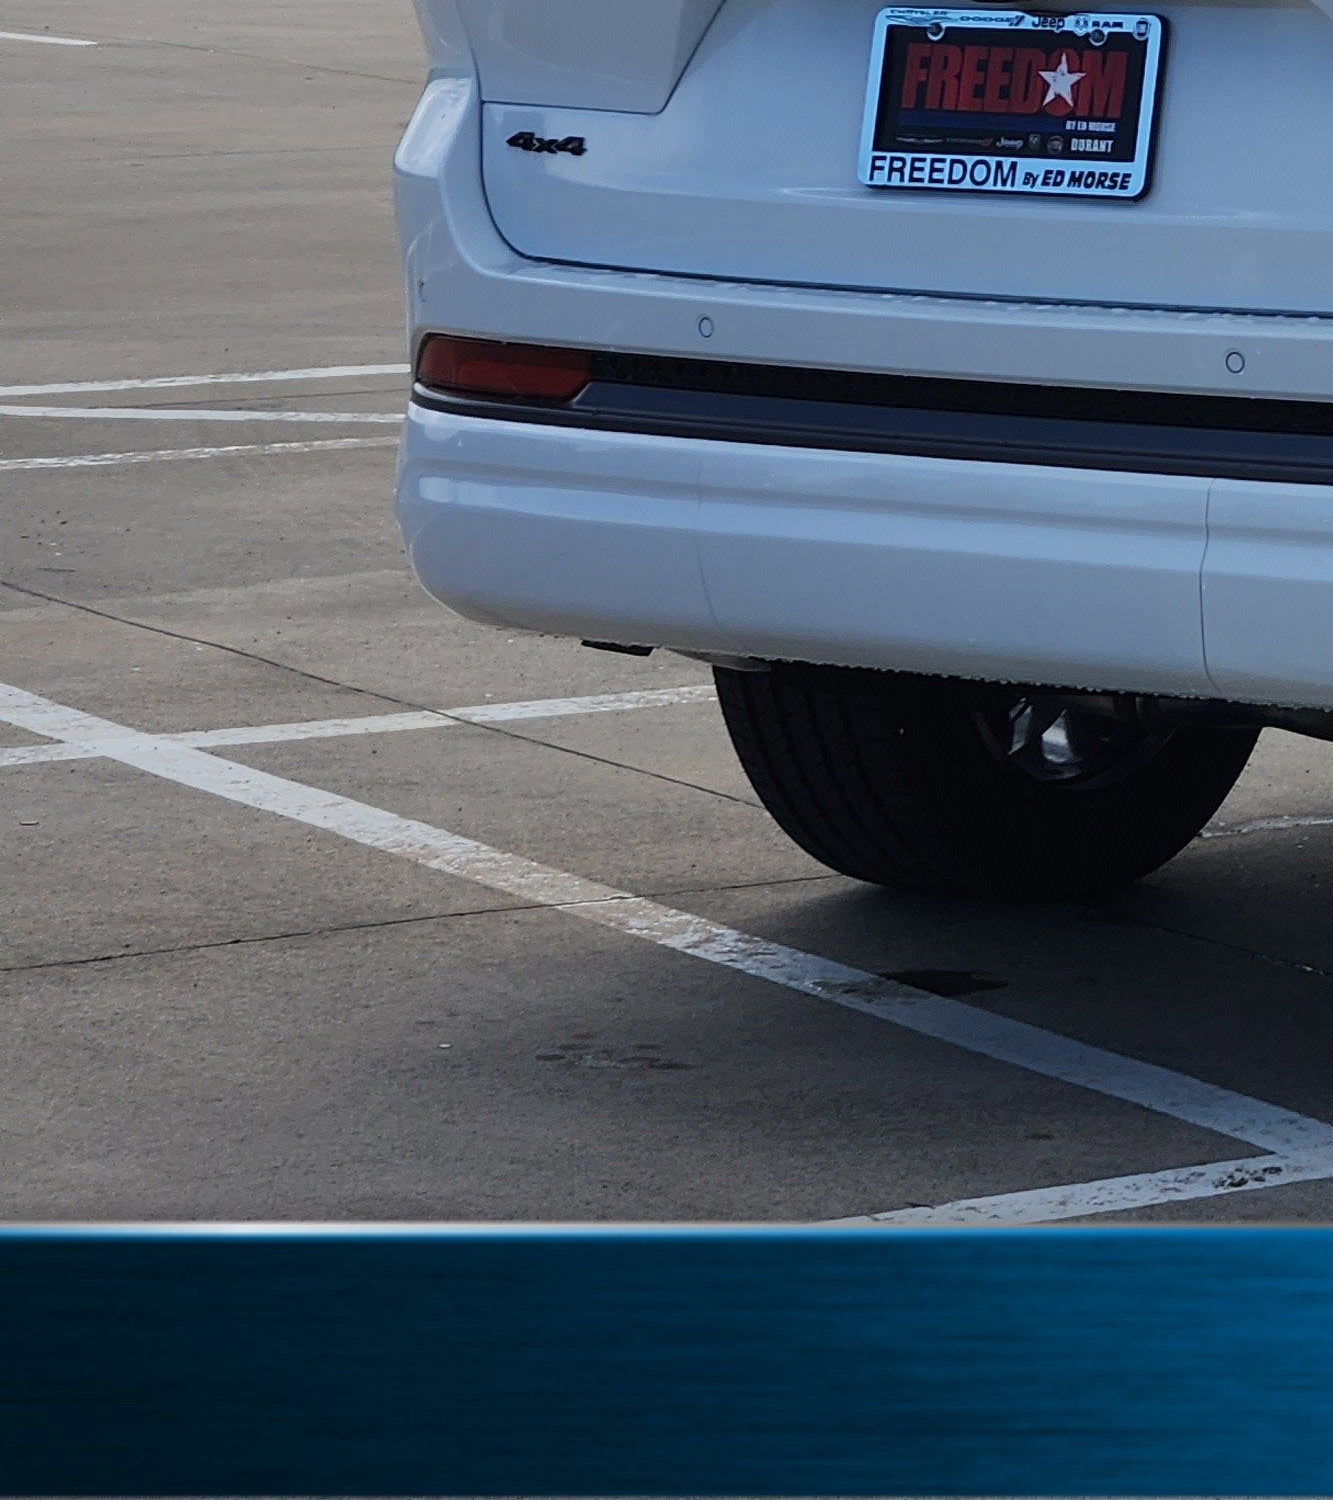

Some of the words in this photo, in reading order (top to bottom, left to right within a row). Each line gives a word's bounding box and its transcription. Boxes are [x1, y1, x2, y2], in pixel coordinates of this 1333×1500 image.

[1031, 16, 1065, 31] Jeep
[901, 43, 1129, 118] FREEDOM
[1070, 138, 1114, 153] DURANT
[868, 155, 1018, 187] FREEDOM
[1041, 170, 1067, 187] ED
[1068, 171, 1133, 190] MORSE
